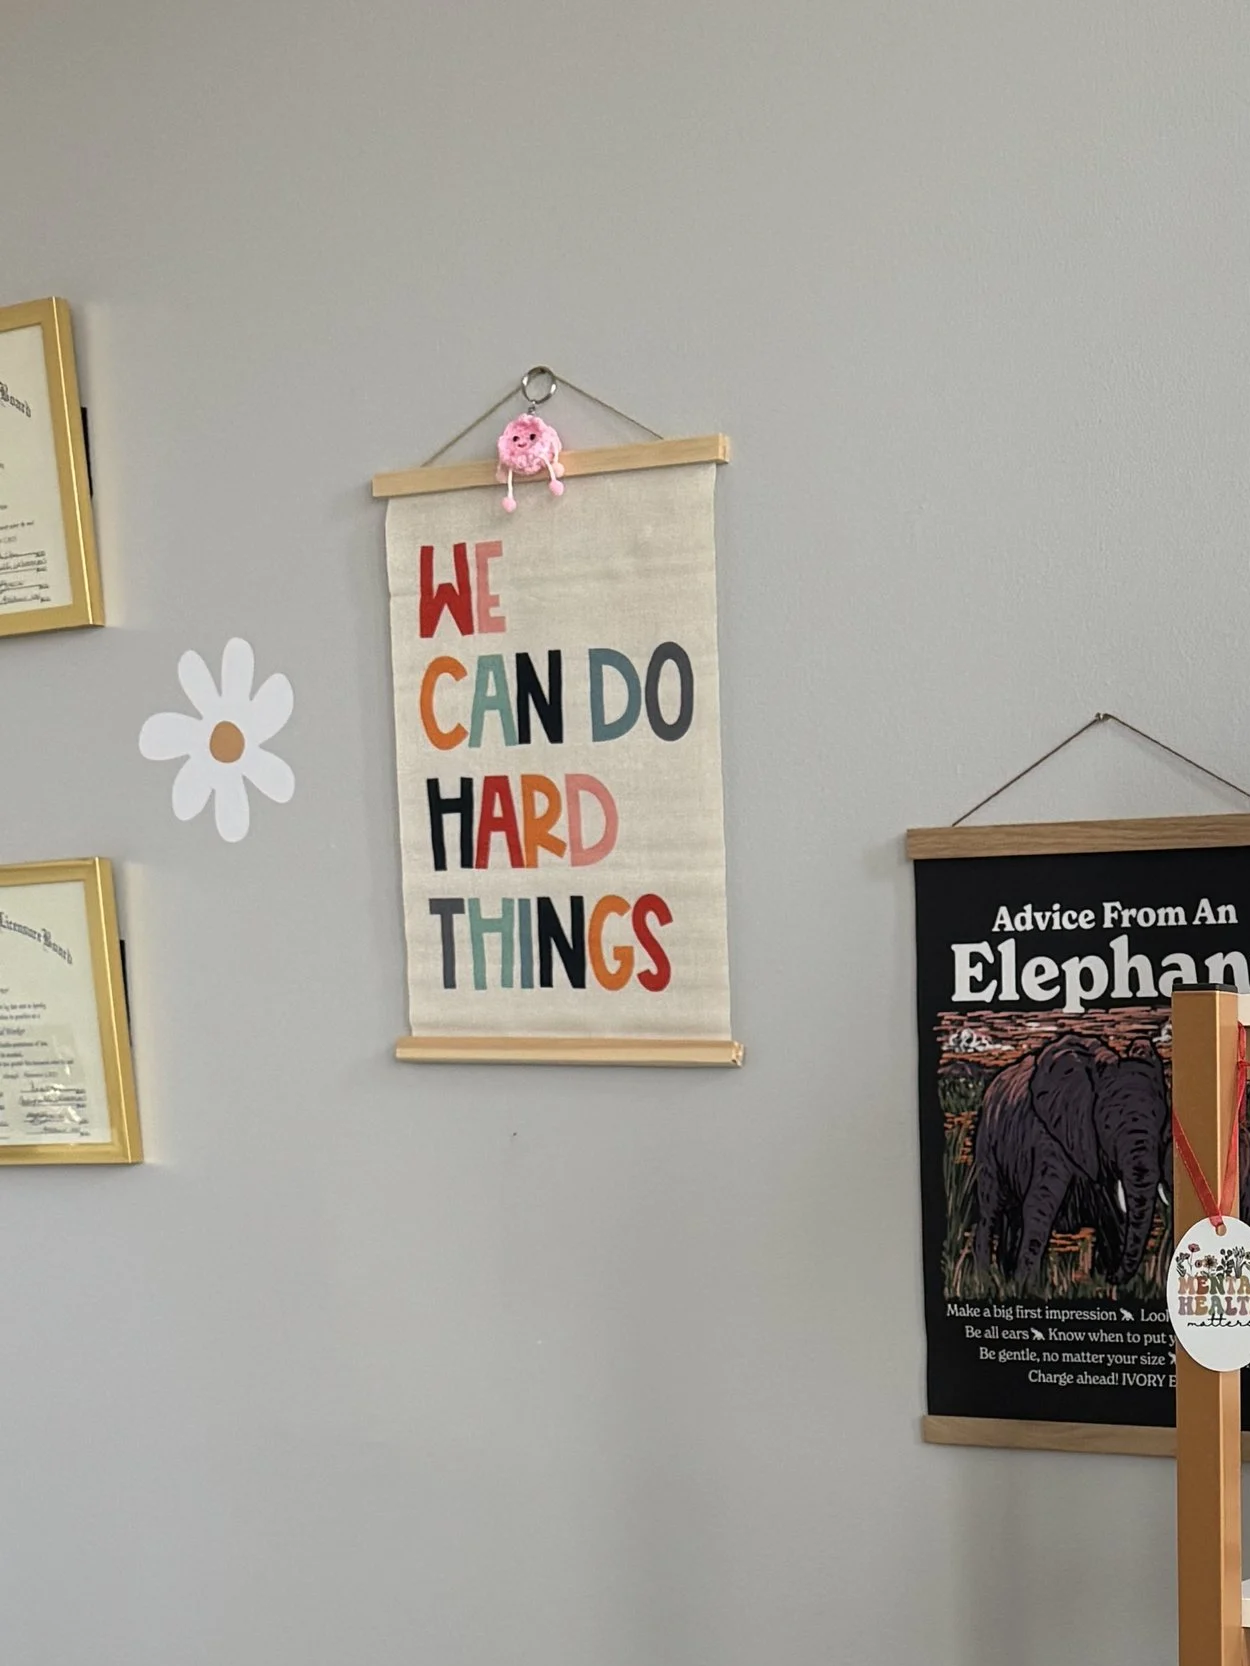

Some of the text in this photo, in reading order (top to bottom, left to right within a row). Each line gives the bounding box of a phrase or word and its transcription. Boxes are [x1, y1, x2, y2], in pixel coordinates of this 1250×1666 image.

[419, 540, 506, 638] WE
[419, 641, 694, 750] CAN DO
[426, 773, 619, 871] HARD
[992, 898, 1238, 933] Advice From An
[429, 893, 673, 992] THINGS
[946, 1304, 980, 1317] Make
[983, 1307, 992, 1317] a
[993, 1305, 1014, 1321] big
[1016, 1305, 1042, 1319] first
[1045, 1306, 1117, 1323] impression
[965, 1326, 983, 1339] Be
[984, 1326, 999, 1339] all
[1002, 1329, 1030, 1340] ears
[1048, 1328, 1086, 1341] Know
[1088, 1329, 1124, 1342] when
[1127, 1331, 1141, 1343] to
[1144, 1331, 1167, 1347] put
[979, 1347, 1166, 1366] Be gentle, no matter your size
[1028, 1370, 1074, 1386] Charge
[1076, 1371, 1119, 1385] ahead!
[1122, 1373, 1169, 1387] IVORY
